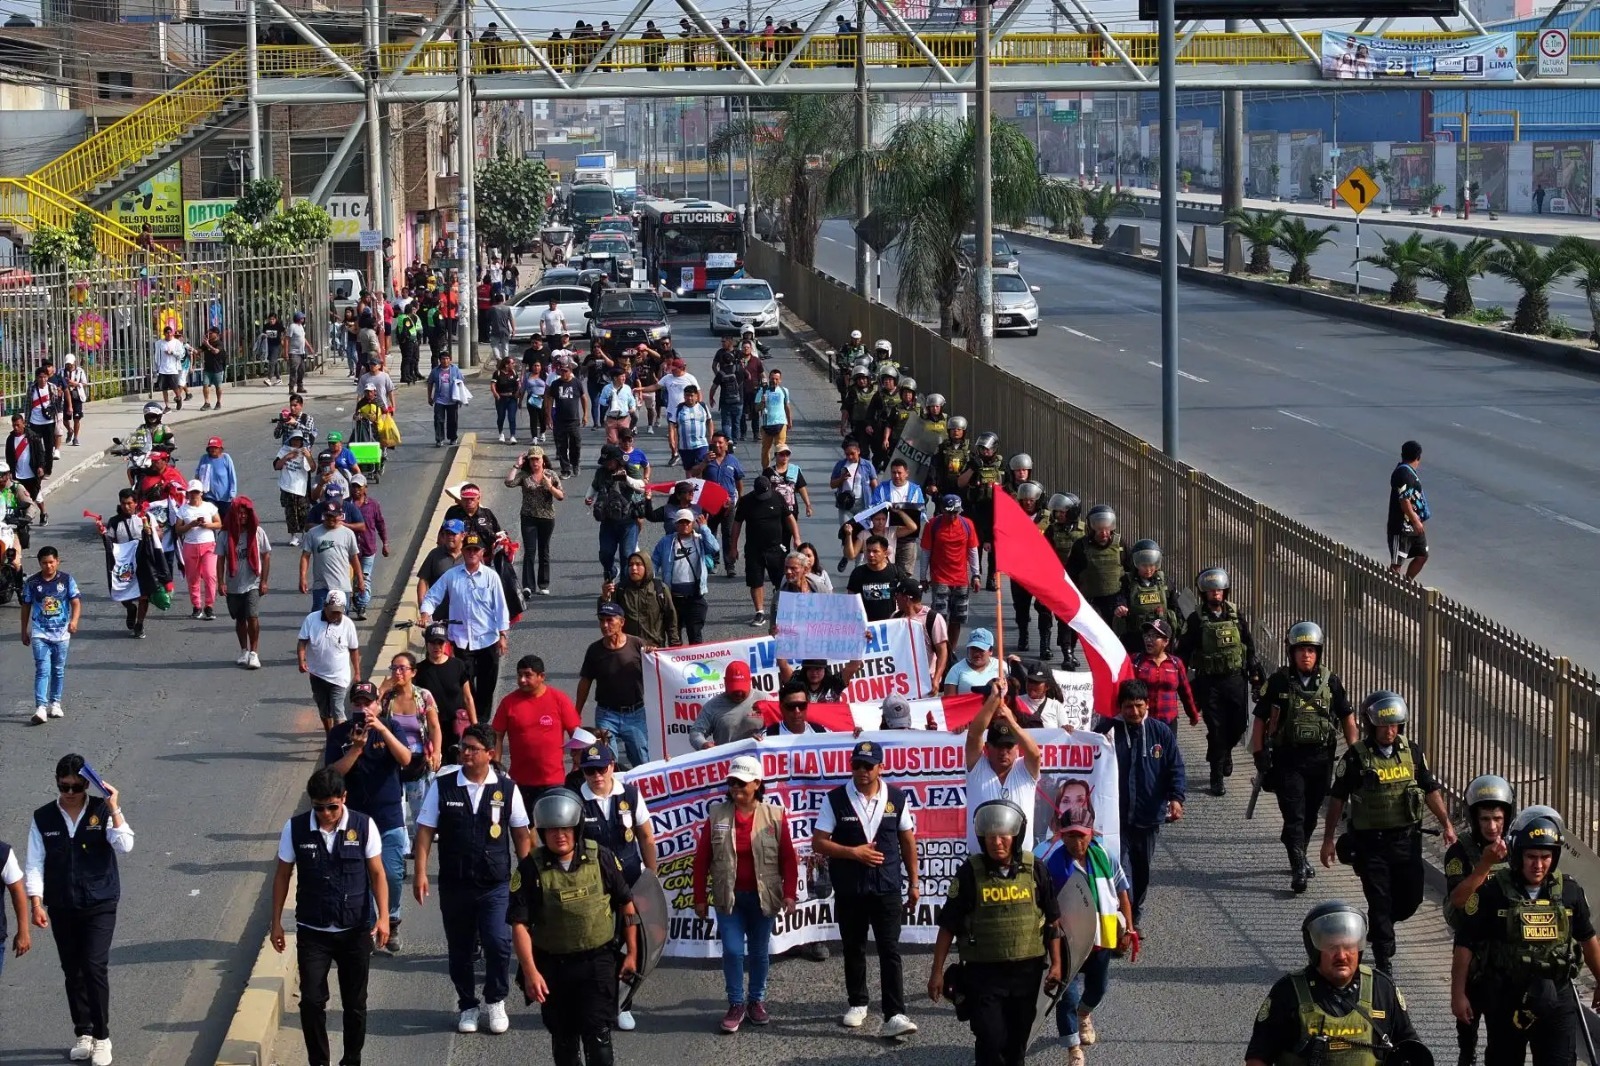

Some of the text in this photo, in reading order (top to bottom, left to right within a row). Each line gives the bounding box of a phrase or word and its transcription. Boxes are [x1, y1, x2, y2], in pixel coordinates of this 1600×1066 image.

[1388, 61, 1404, 70] 25
[1489, 61, 1514, 69] LIMA
[150, 215, 163, 223] 915
[188, 204, 233, 225] ORTOP
[558, 386, 574, 399] LA
[896, 438, 932, 467] POLICIA
[671, 649, 731, 663] COORDINADORA
[680, 684, 716, 694] DISTRITAL
[752, 674, 774, 692] NO
[669, 760, 731, 793] DEFEN
[762, 753, 789, 777] DE
[793, 751, 819, 775] LA
[882, 745, 965, 770] JUSTICI
[927, 786, 968, 806] FA
[1528, 828, 1559, 840] POLICIA
[656, 831, 695, 858] DE
[926, 841, 952, 855] YA
[772, 903, 834, 936] CIONA
[1525, 927, 1555, 937] POLICIA
